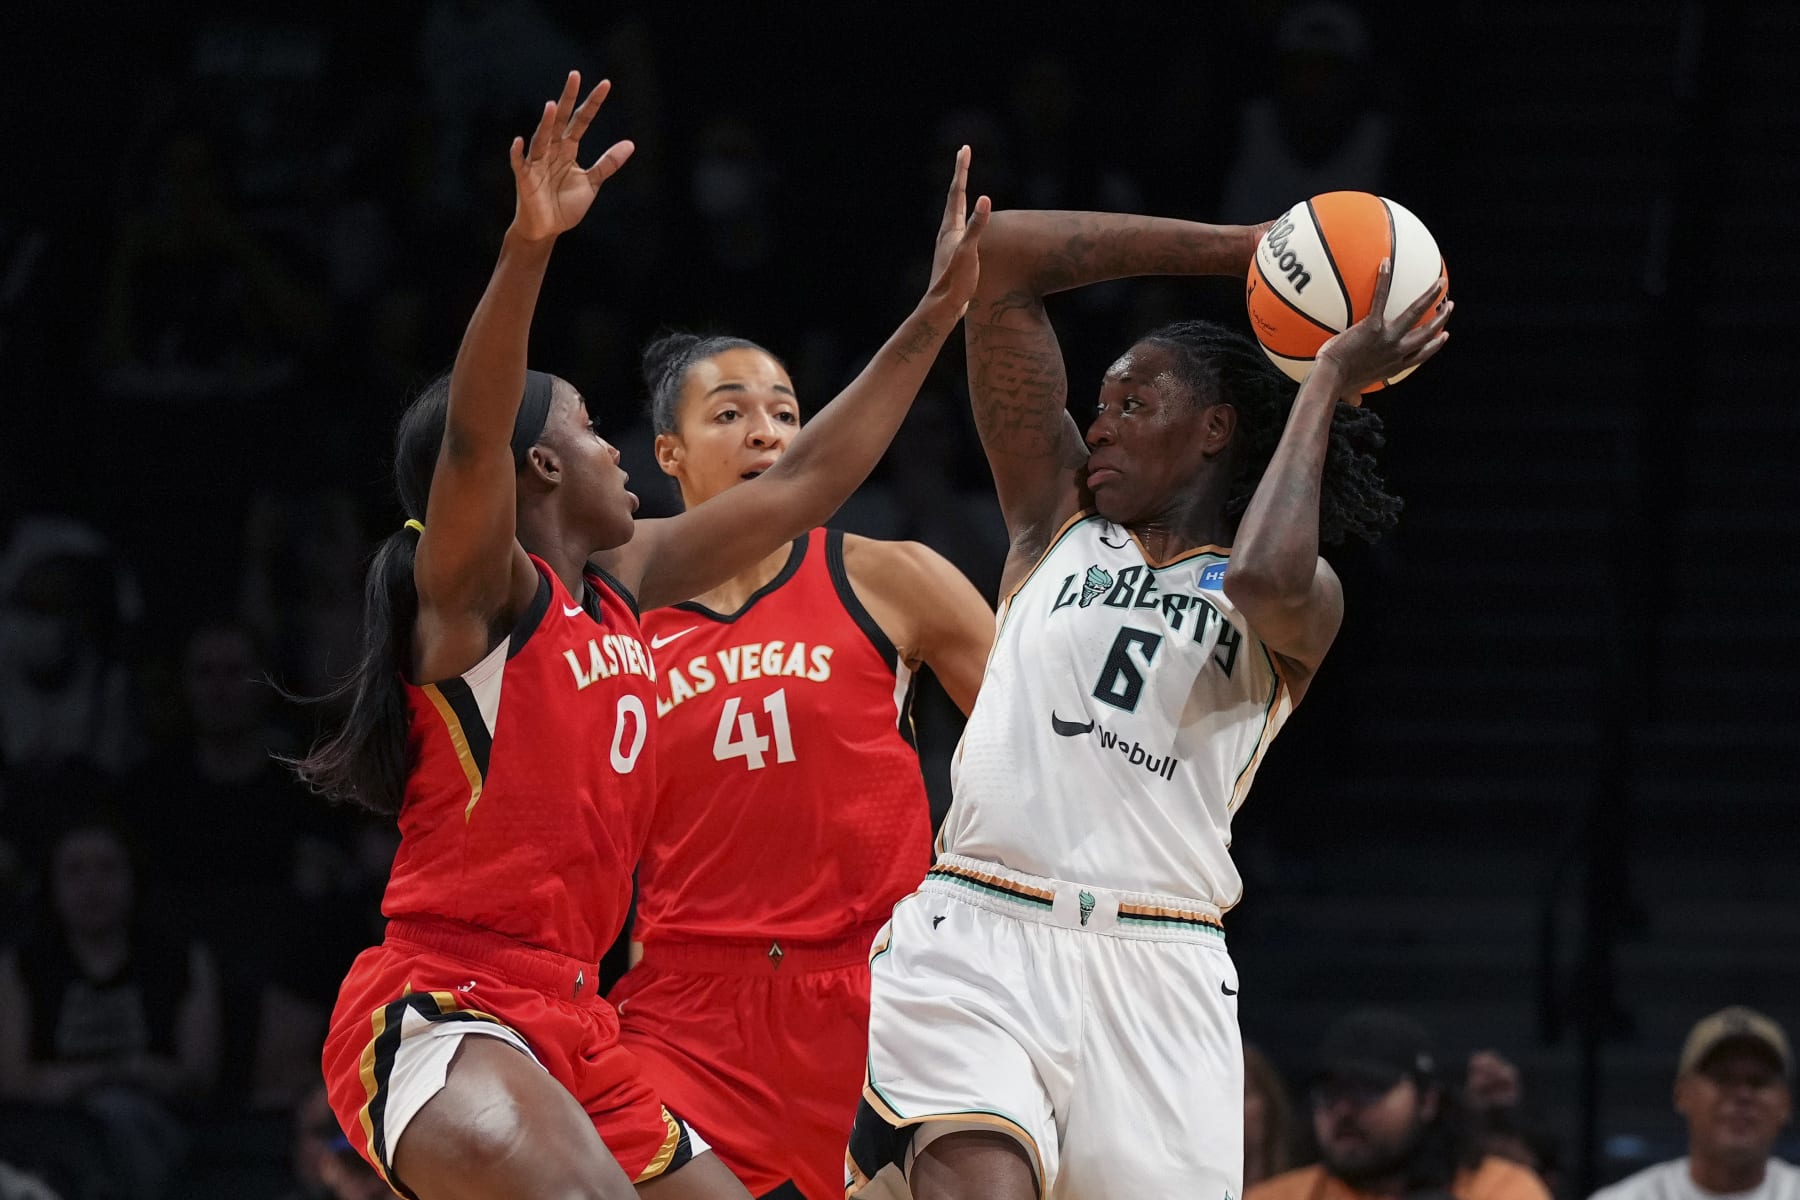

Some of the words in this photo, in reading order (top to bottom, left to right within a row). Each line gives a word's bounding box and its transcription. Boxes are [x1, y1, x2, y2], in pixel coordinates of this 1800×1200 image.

[1267, 211, 1312, 295] ilson
[562, 634, 619, 691] LAS
[717, 641, 834, 682] VEGAS
[1091, 626, 1164, 714] 6
[610, 694, 647, 774] 0
[713, 688, 797, 771] 41
[1099, 724, 1178, 781] Webull
